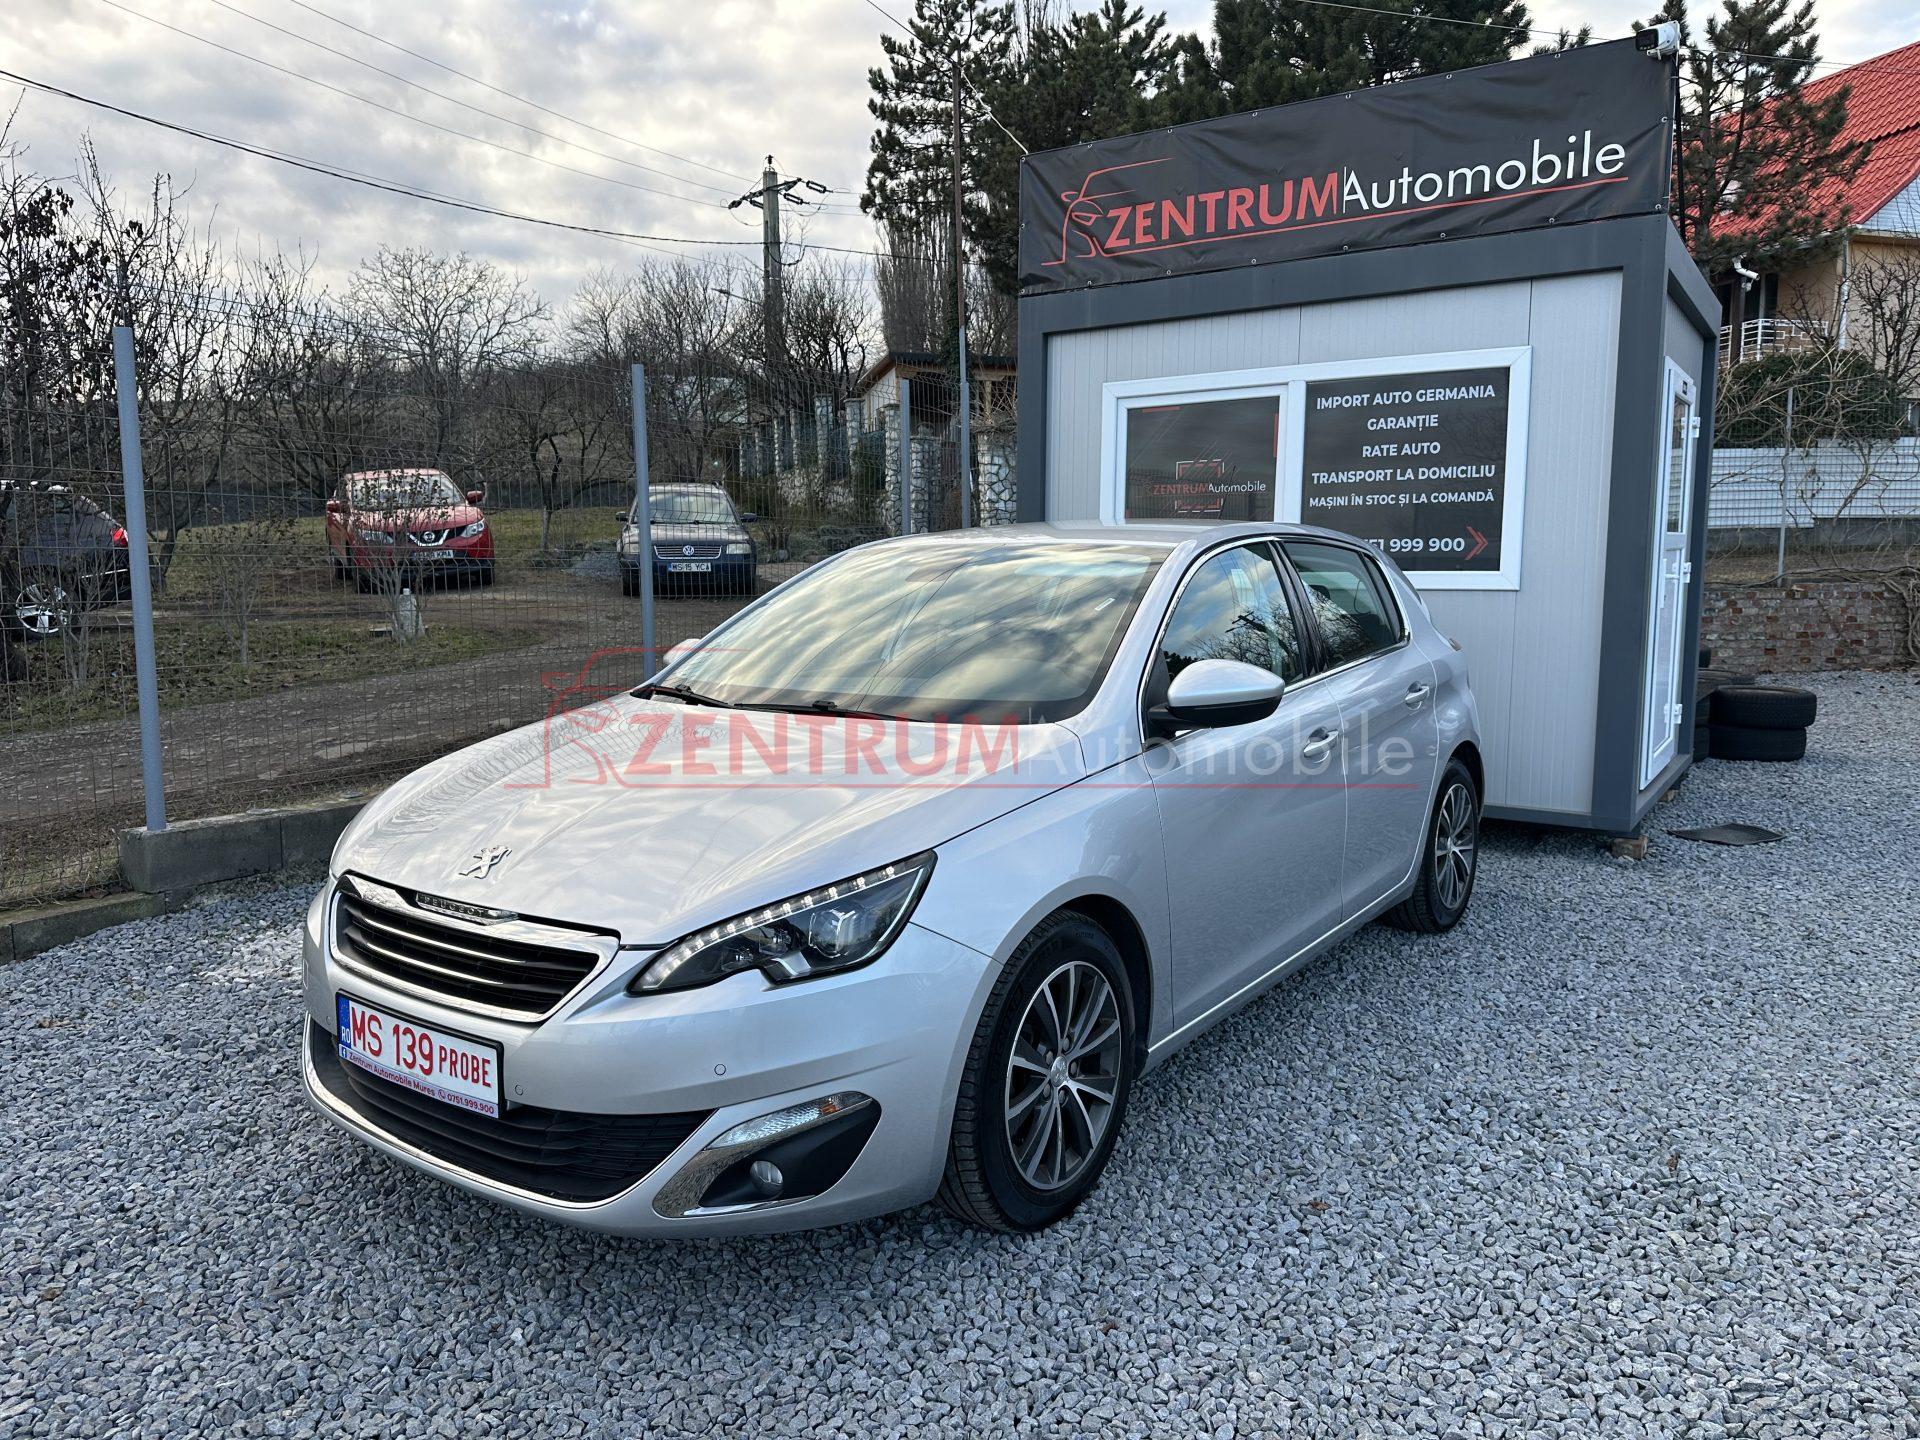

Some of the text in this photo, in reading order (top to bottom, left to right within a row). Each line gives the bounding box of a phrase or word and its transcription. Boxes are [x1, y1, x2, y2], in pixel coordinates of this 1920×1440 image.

[1103, 130, 1625, 250] ZENTRUM Automobile
[1316, 385, 1495, 410] IMPORT AUTO GERMANIA
[1367, 414, 1439, 432] GARANȚIE
[1362, 442, 1441, 458] RATE AUTO
[1312, 465, 1495, 485] TRANSPORT LA DOMICILIU
[1153, 480, 1266, 495] ZENTRUM Automobile
[1309, 489, 1494, 509] MAȘINI ÎN STOC ȘI LA COMANDĂ
[1389, 538, 1424, 552] 999
[1428, 537, 1465, 552] 900
[424, 896, 485, 917] PEUGEOT
[341, 1007, 492, 1089] RO MS 139 PROBE
[350, 1053, 373, 1071] Zentrum
[374, 1065, 412, 1086] Automobile
[447, 1094, 495, 1115] 0751.999.900
